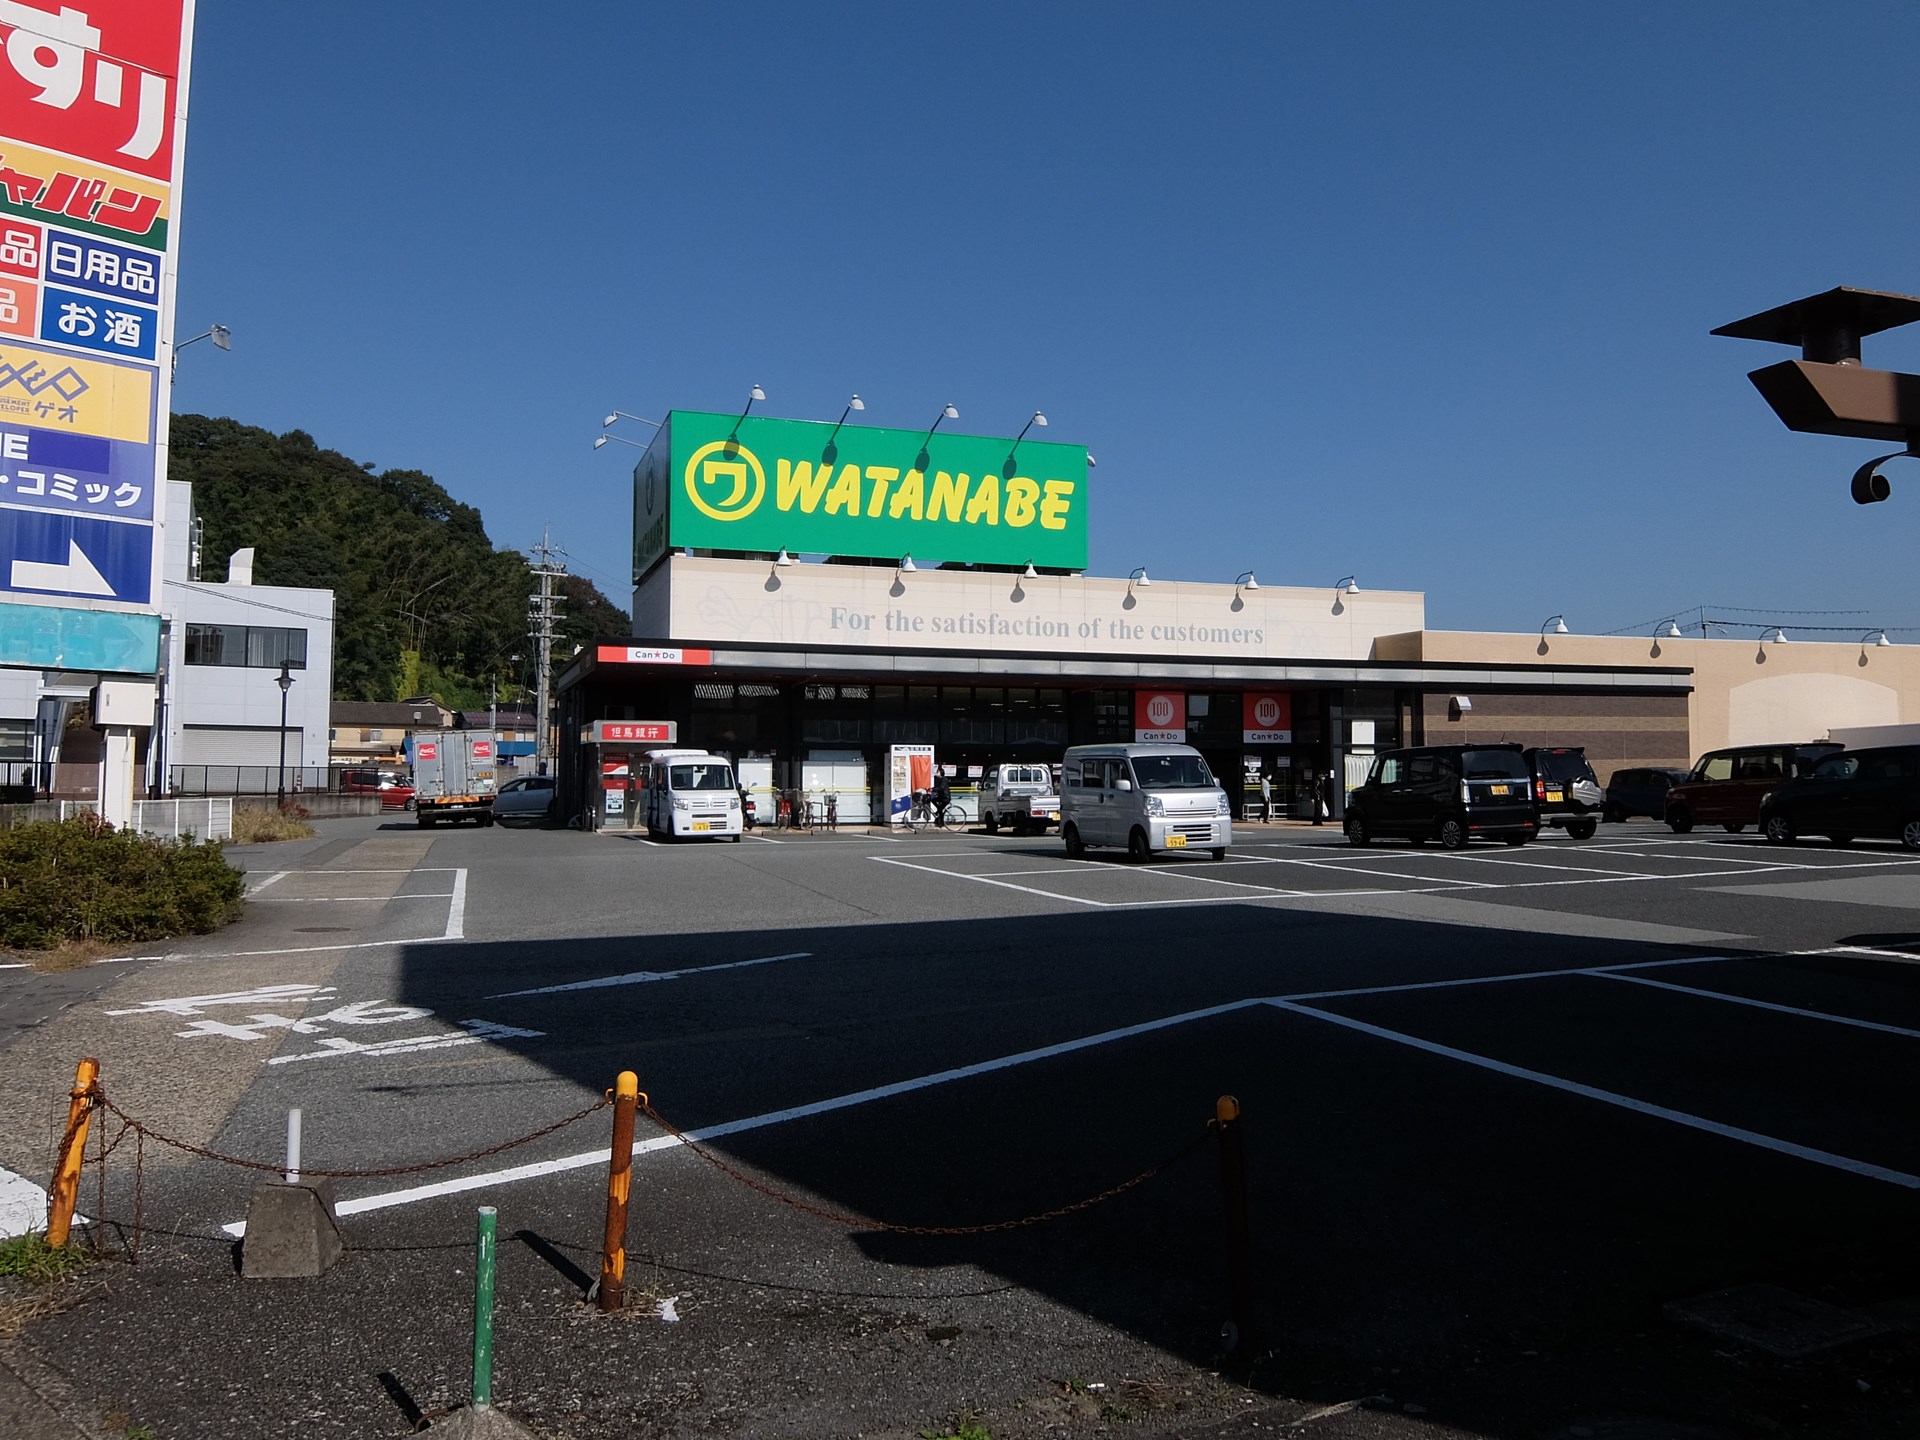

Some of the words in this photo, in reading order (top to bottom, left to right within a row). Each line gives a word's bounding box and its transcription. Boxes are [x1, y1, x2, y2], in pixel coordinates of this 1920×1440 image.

[0, 0, 167, 160] すり
[0, 154, 162, 235] ャパン
[0, 229, 38, 268] 品
[50, 240, 155, 295] 日用品
[58, 302, 142, 348] お酒
[34, 401, 78, 423] ゲオ
[776, 457, 1075, 531] WATANABE
[829, 606, 876, 631] For
[884, 609, 924, 633] the
[931, 611, 1070, 638] satisfaction
[1077, 616, 1101, 639] of
[1109, 617, 1144, 641] the
[1150, 622, 1264, 645] customers
[1152, 701, 1168, 717] 100
[1259, 703, 1275, 718] 100
[612, 727, 659, 738] 但馬銀行
